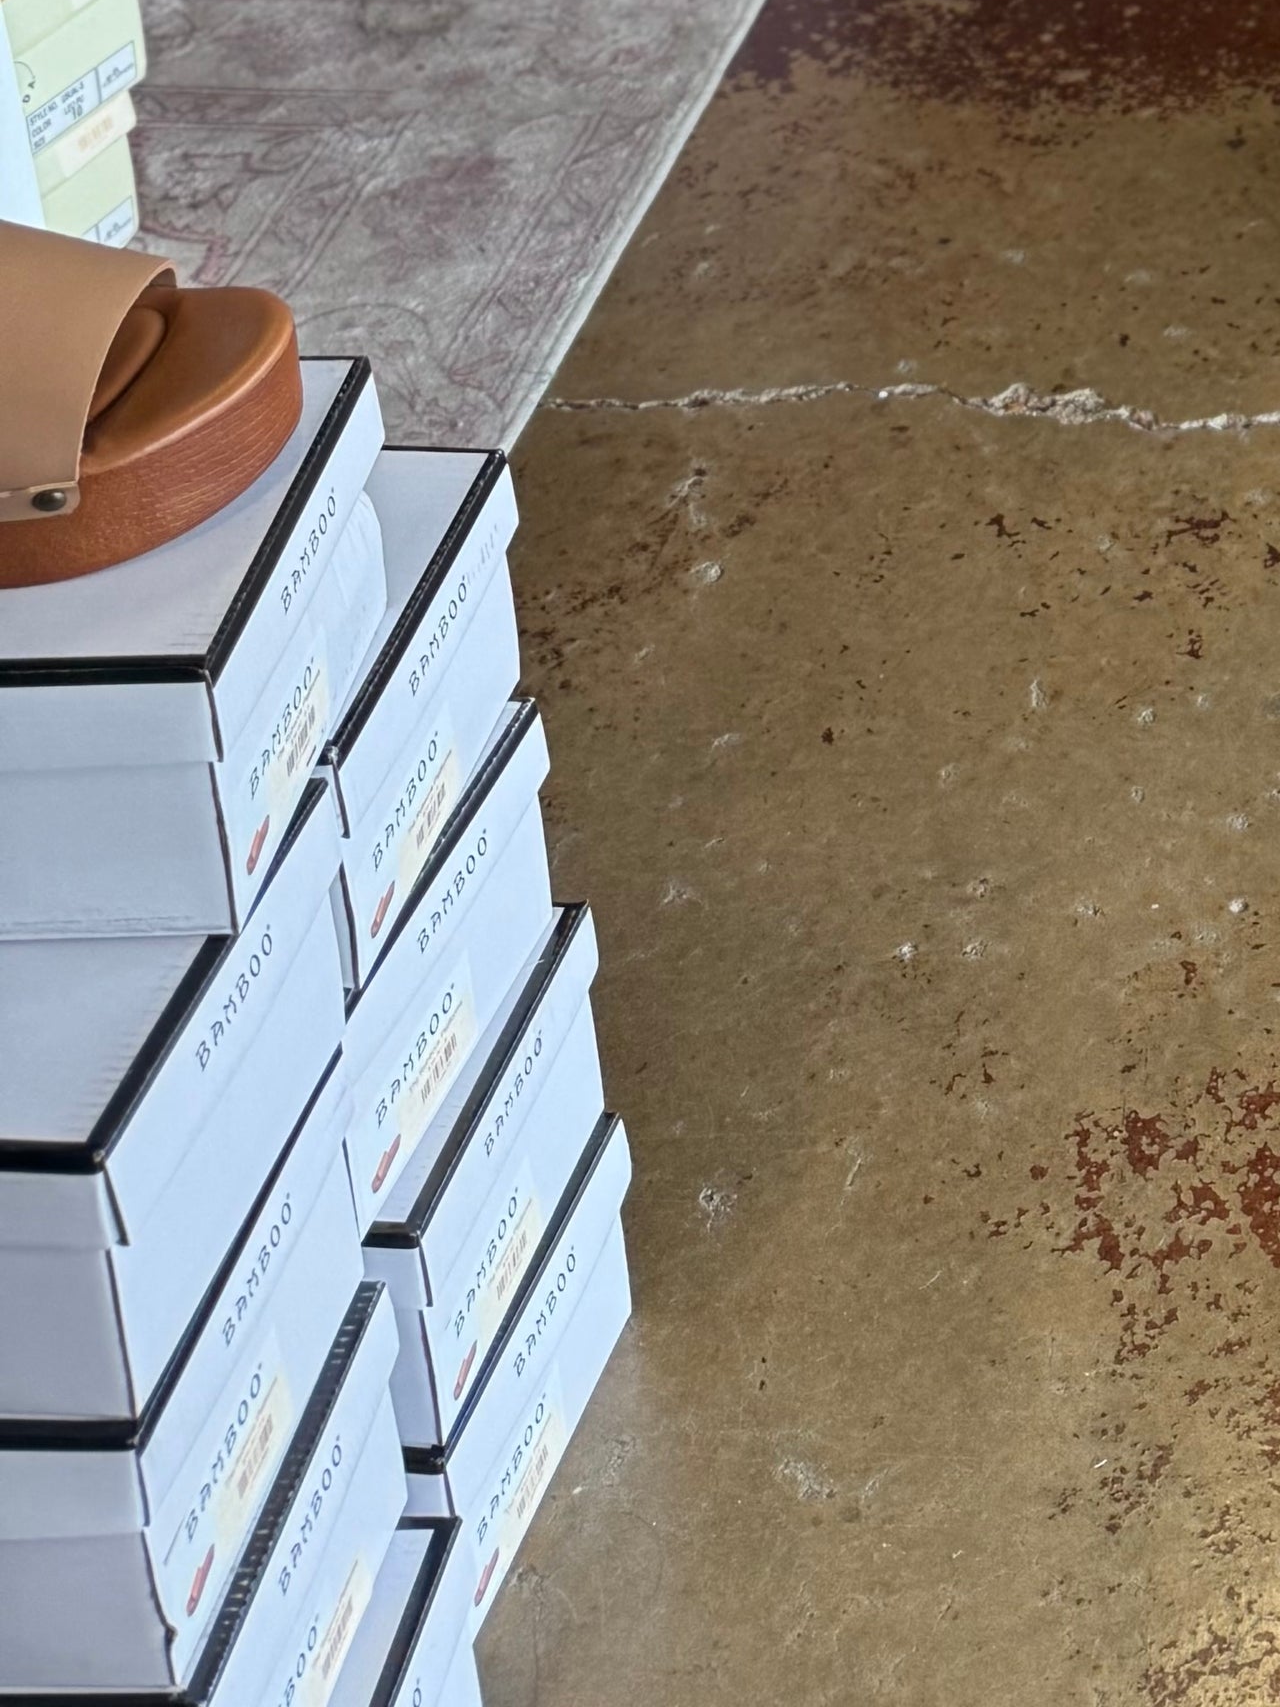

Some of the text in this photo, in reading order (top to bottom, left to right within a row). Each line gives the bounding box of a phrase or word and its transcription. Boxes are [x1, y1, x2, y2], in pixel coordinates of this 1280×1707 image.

[280, 495, 337, 615] BAMBOO
[408, 583, 468, 697] BAMBOO
[250, 666, 312, 800] BAMBOO
[372, 739, 438, 872] BAMBOO
[416, 835, 488, 954] BAMBOO
[195, 933, 273, 1071] BAMBOO
[375, 992, 452, 1129] BAMBOO
[484, 1038, 543, 1157] BAMBOO
[222, 1199, 292, 1348] BAMBOO
[454, 1196, 517, 1340] BAMBOO
[514, 1257, 577, 1378] BAMBOO
[185, 1372, 262, 1544] BAMBOO
[278, 1445, 343, 1597] BAMBOO
[477, 1402, 545, 1546] BAMBOO
[283, 1626, 318, 1707] BOO
